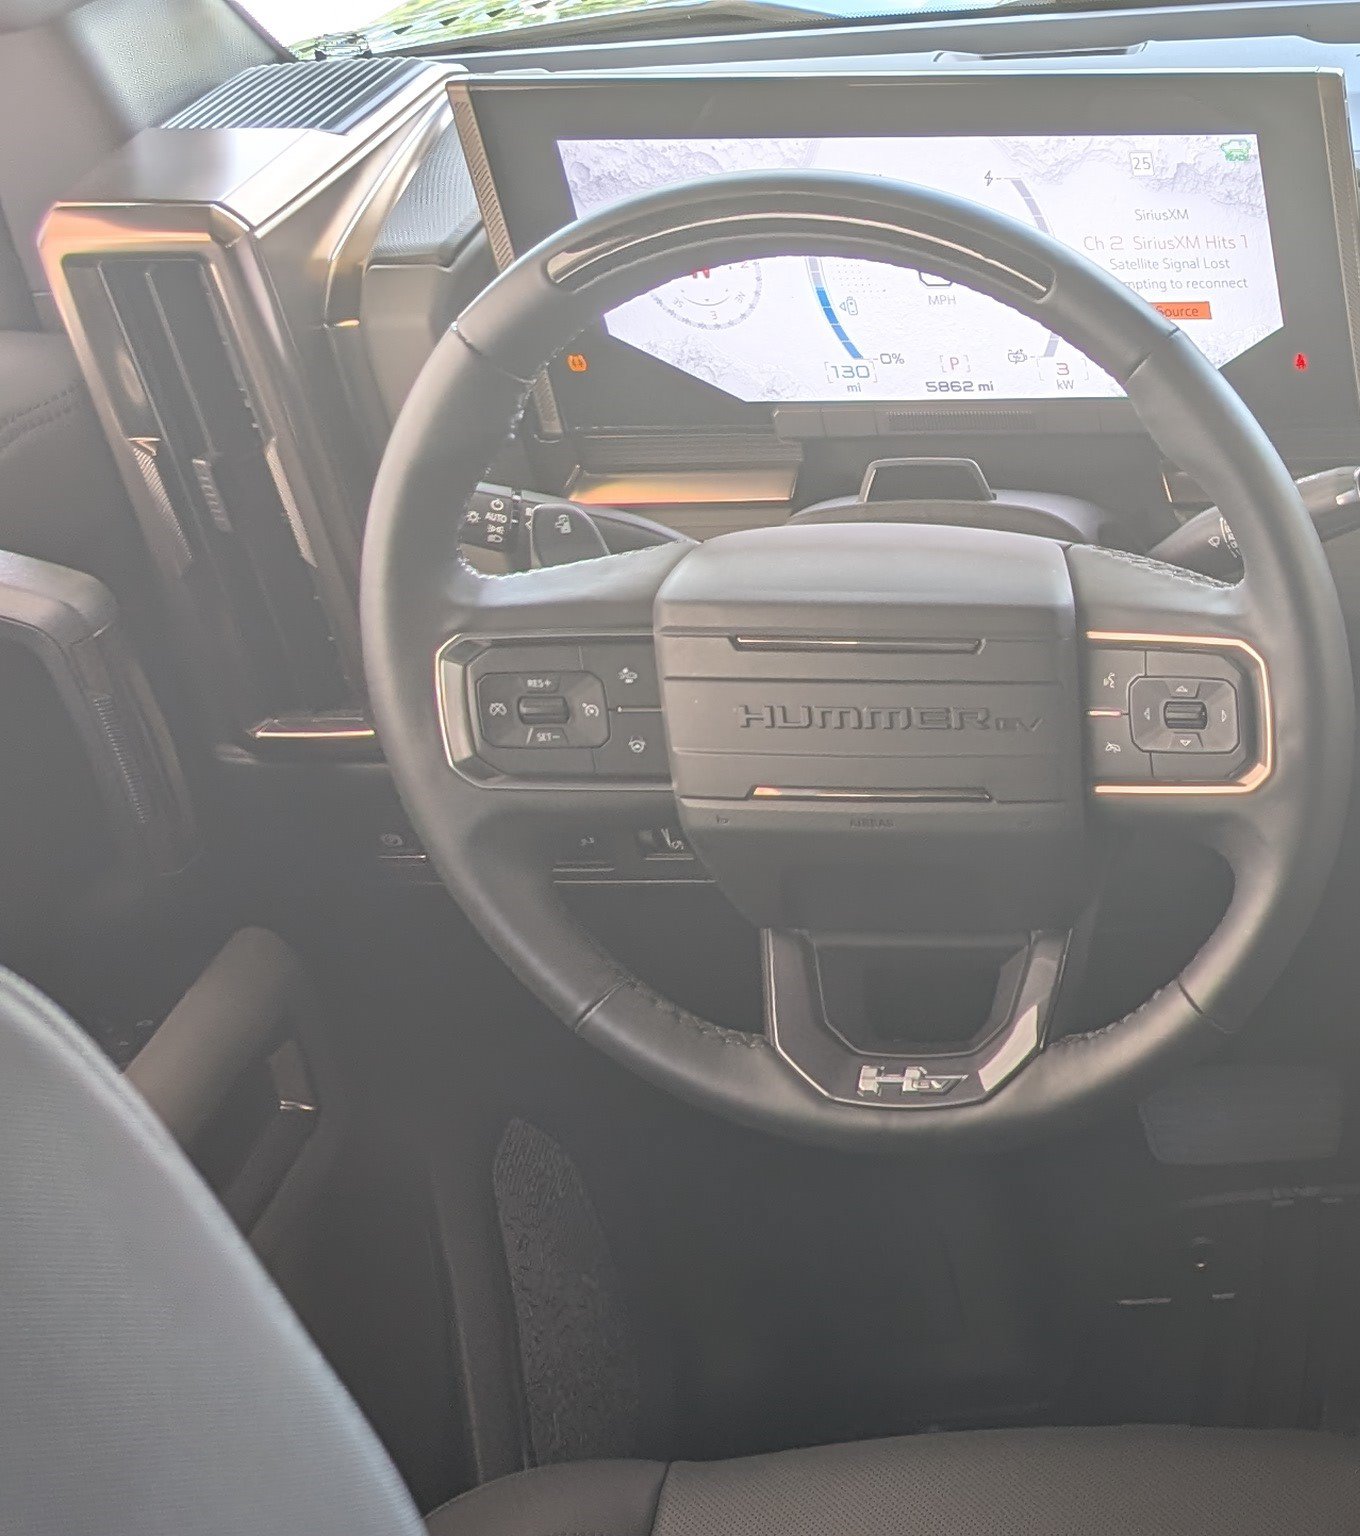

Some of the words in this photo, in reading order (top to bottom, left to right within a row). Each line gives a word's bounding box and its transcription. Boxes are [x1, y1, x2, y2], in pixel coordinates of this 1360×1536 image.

[1132, 156, 1152, 171] 25
[1134, 208, 1189, 222] SiriusXM
[1083, 235, 1105, 251] Ch
[1110, 235, 1124, 250] 2
[1133, 235, 1201, 251] SiriusXM
[1205, 234, 1237, 250] Hits
[1240, 234, 1249, 249] 1
[1109, 258, 1160, 271] Satellite
[1163, 257, 1200, 273] Signal
[1204, 256, 1231, 270] Lost
[1170, 278, 1184, 291] to
[1186, 277, 1249, 291] reconnect
[927, 294, 956, 306] MPH
[879, 353, 905, 365] 0%
[949, 357, 960, 370] P
[826, 365, 870, 379] 130
[1056, 363, 1070, 376] 3
[846, 383, 862, 393] mi
[925, 381, 974, 393] 5862
[978, 381, 995, 392] mi
[1056, 379, 1076, 391] kW
[485, 511, 508, 524] AUTO
[737, 704, 990, 731] HUMMER
